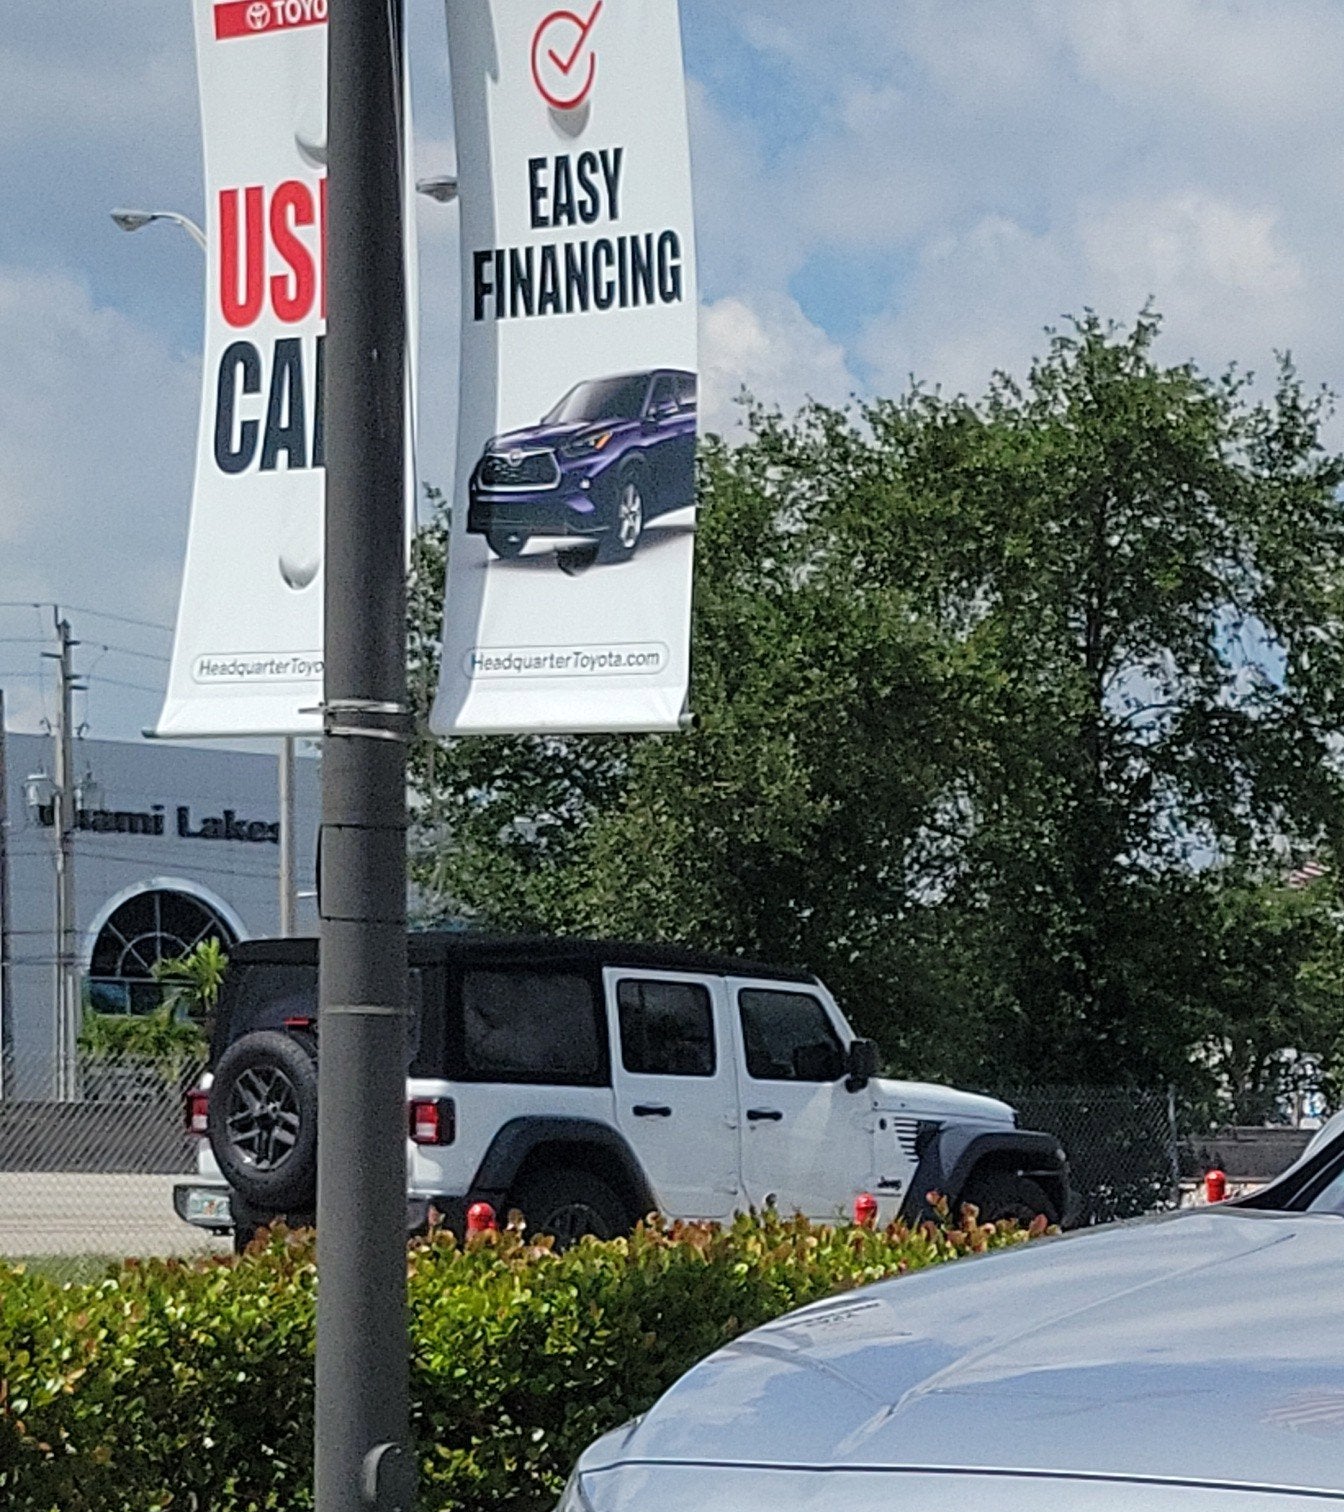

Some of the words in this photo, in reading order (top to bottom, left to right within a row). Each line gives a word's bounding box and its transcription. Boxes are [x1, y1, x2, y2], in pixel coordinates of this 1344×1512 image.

[528, 147, 623, 229] EASY
[219, 180, 327, 327] US
[473, 229, 682, 322] FINANCING
[214, 337, 326, 474] CA
[471, 651, 660, 673] HeadquarterToyota.com
